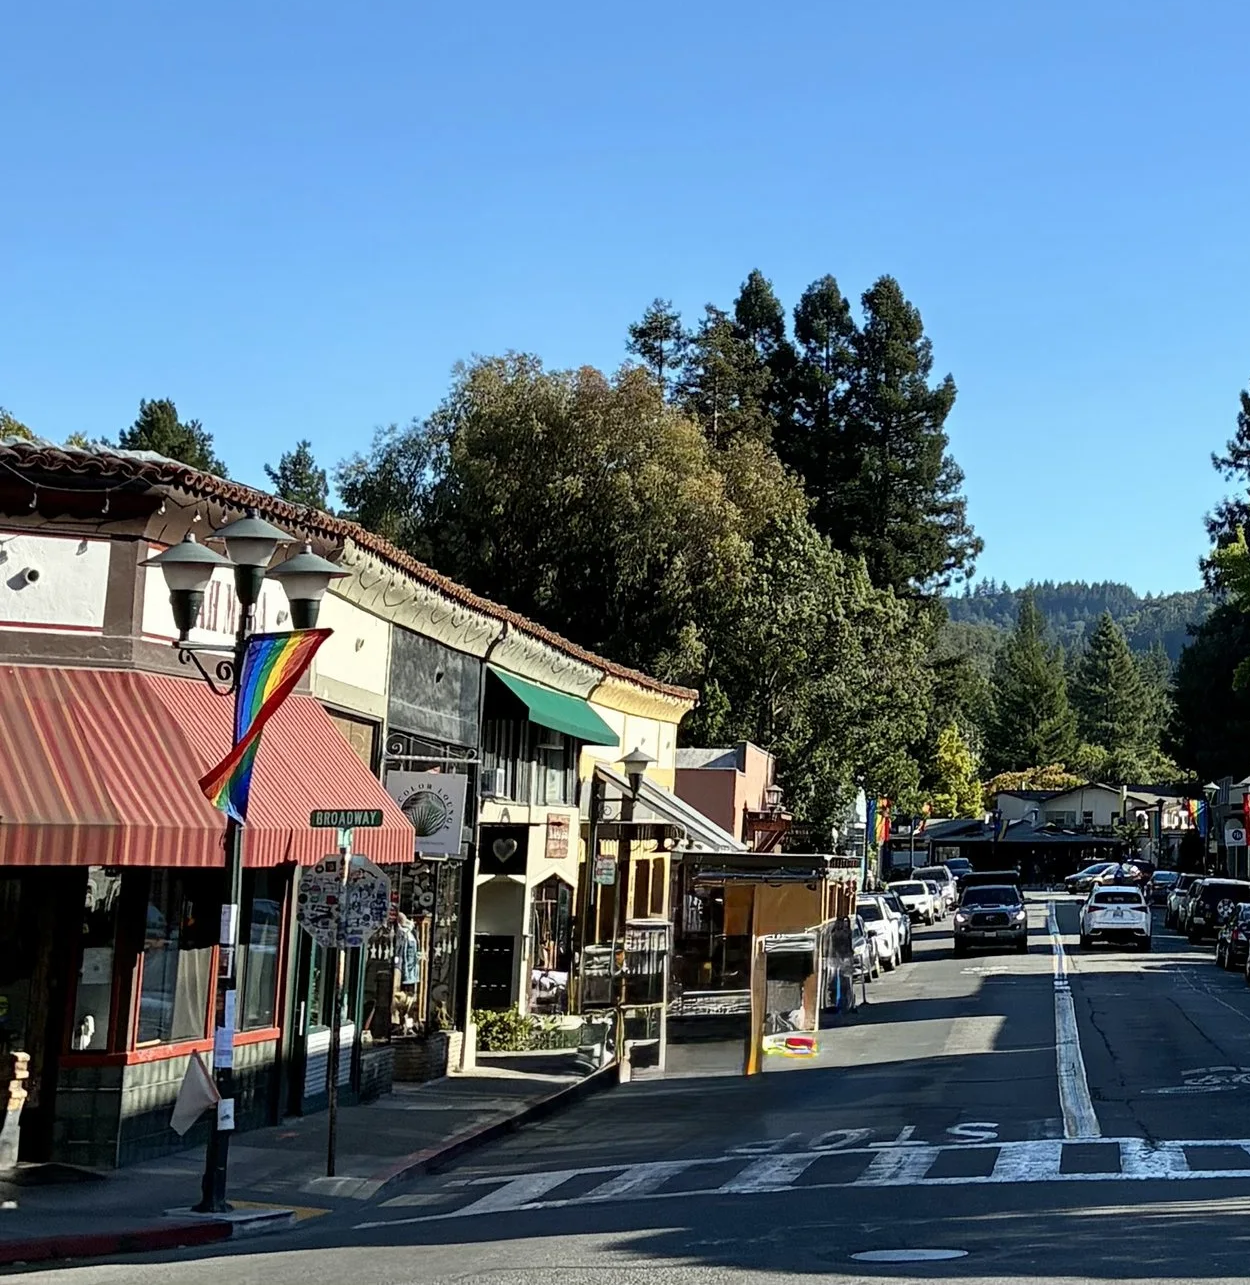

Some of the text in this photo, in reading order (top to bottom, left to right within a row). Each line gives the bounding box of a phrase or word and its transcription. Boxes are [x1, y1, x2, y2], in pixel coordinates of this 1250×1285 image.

[397, 783, 432, 803] COLOR
[316, 811, 377, 825] BROADWAY
[724, 1122, 1000, 1154] STOP
